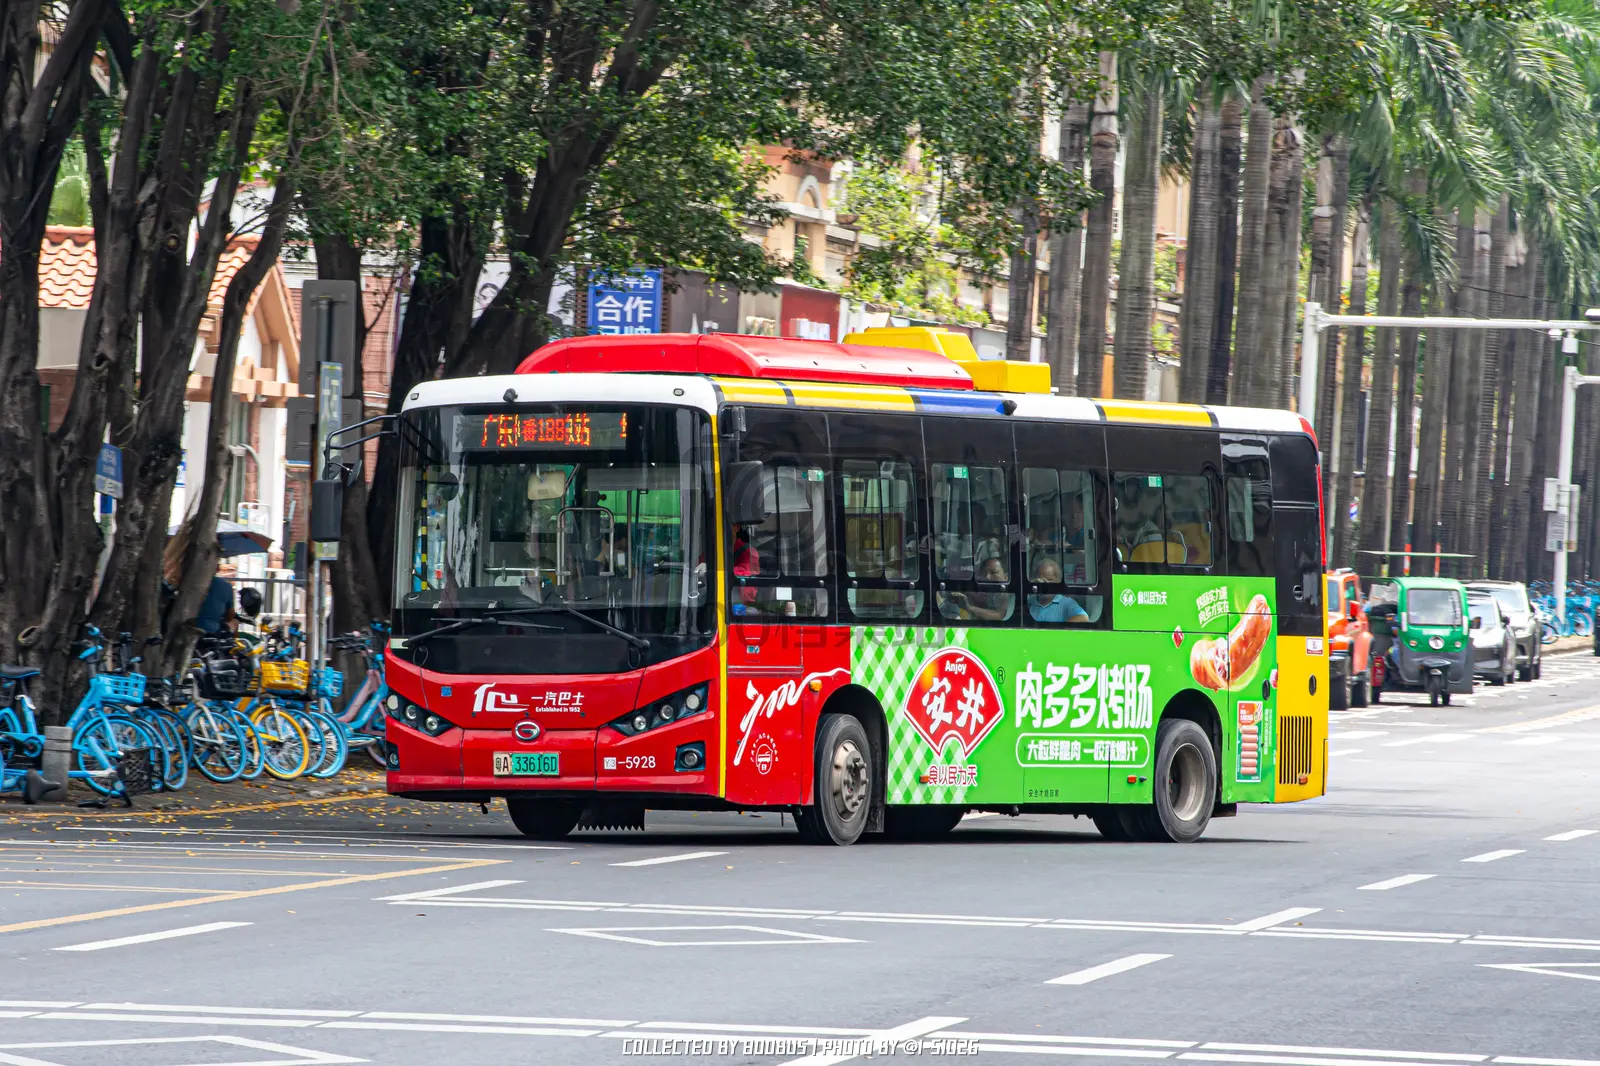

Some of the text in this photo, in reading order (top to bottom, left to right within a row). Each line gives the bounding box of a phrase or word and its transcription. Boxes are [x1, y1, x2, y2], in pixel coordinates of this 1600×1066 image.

[595, 295, 654, 323] 合作
[1137, 591, 1168, 605] 食以民为天
[944, 656, 967, 675] Anjoy
[531, 691, 585, 706] 一汽巴士
[921, 676, 985, 734] 安井
[1015, 661, 1153, 729] 肉多多烤肠
[1027, 740, 1081, 761] 大粒鲜腿肉
[928, 764, 978, 786] 食以民为天
